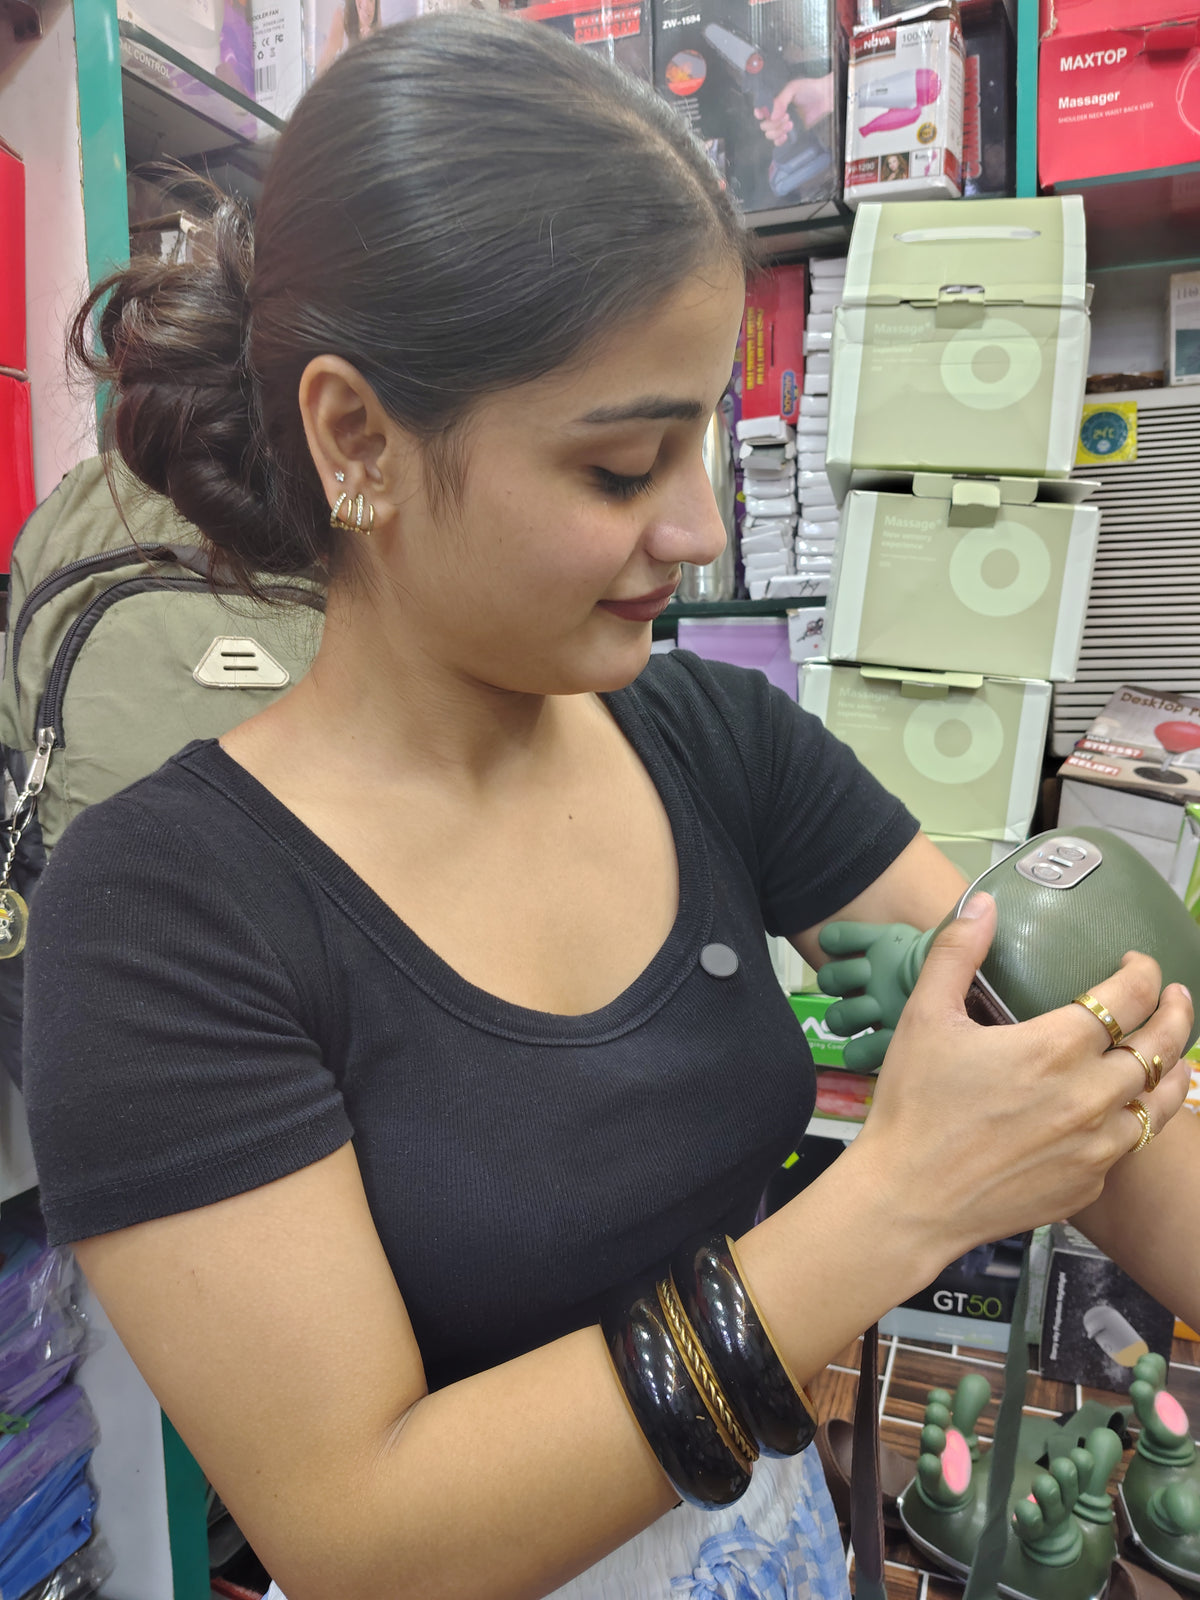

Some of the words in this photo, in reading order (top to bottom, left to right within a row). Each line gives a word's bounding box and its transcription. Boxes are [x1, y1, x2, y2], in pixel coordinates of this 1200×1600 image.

[863, 36, 890, 50] NOVA
[133, 48, 170, 79] CONTROL
[1060, 47, 1127, 72] MAXTOP
[1058, 91, 1120, 110] Massager
[1120, 692, 1184, 714] Desktop
[1083, 740, 1141, 757] STRESS?
[1068, 757, 1119, 775] RELIEF!
[933, 1289, 1002, 1319] GT50
